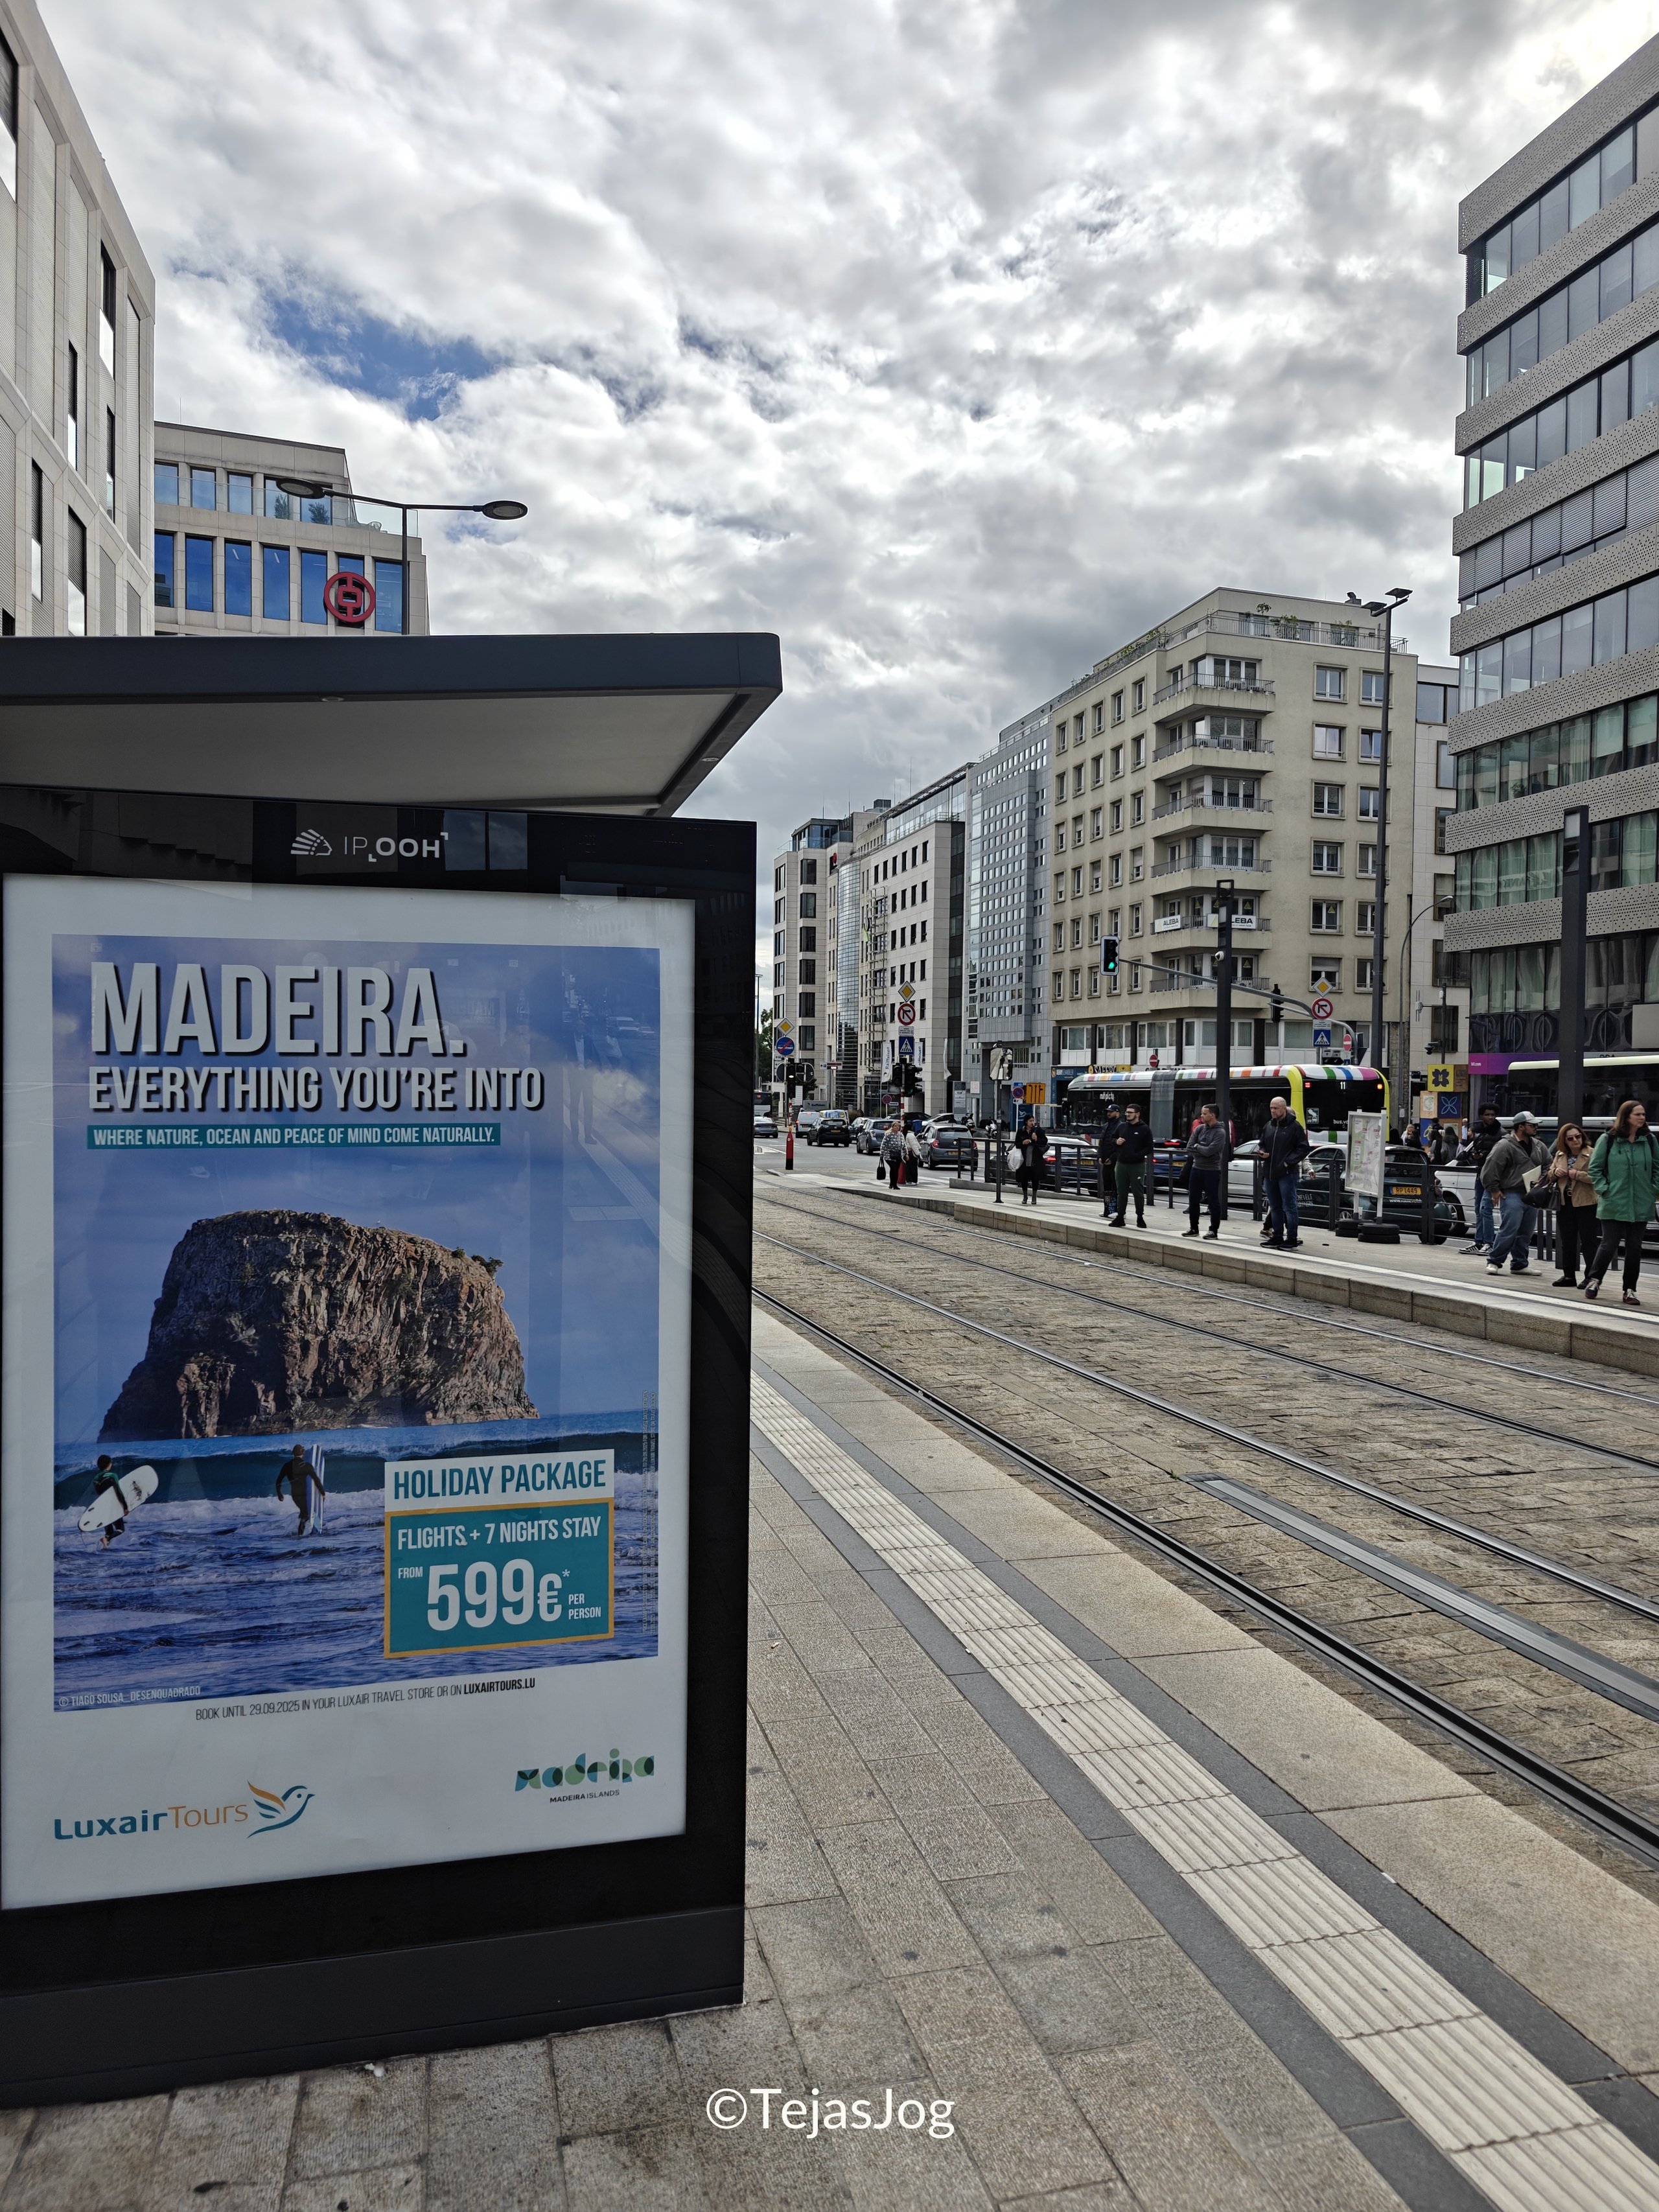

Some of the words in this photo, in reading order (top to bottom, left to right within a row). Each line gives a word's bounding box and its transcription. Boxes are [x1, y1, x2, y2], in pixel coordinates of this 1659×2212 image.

[1163, 918, 1179, 926] ALEBA
[91, 962, 465, 1055] MADEIRA.
[89, 1066, 320, 1110] EVERYTHING
[329, 1067, 456, 1110] YOU'RE
[465, 1067, 542, 1109] INTO
[1340, 1081, 1346, 1090] 11
[93, 1129, 143, 1145] WHERE
[146, 1128, 203, 1146] NATURE,
[206, 1128, 251, 1145] OCEAN
[253, 1128, 281, 1144] AND
[285, 1128, 325, 1144] PEACE
[329, 1128, 345, 1143] OF
[348, 1128, 381, 1143] MIND
[384, 1127, 419, 1143] COME
[423, 1126, 494, 1143] NATURALLY.
[394, 1465, 494, 1500] HOLIDAY
[501, 1459, 606, 1493] PACKAGE
[397, 1525, 466, 1550] FLIGHTS
[469, 1529, 481, 1541] +
[485, 1523, 495, 1544] 7
[500, 1519, 559, 1544] NIGHTS
[562, 1516, 602, 1539] STAY
[397, 1566, 423, 1579] FROM
[568, 1593, 585, 1606] PER
[568, 1606, 601, 1620] PERSON
[71, 1695, 95, 1706] TIAGO
[196, 1707, 220, 1721] BOOK
[222, 1705, 248, 1718] UNTIL
[249, 1699, 301, 1716] 29.09.2025
[302, 1698, 310, 1711] IN
[312, 1696, 336, 1710] YOUR
[338, 1693, 370, 1708] LUXAIR
[372, 1690, 406, 1704] TRAVEL
[408, 1687, 435, 1701] STORE
[437, 1685, 448, 1698] OR
[451, 1684, 462, 1696] ON
[463, 1677, 536, 1695] LUXAIRTOURS.LU
[515, 1748, 655, 1792] madeira
[550, 1793, 585, 1804] MADEIRA
[586, 1789, 620, 1799] ISLANDS
